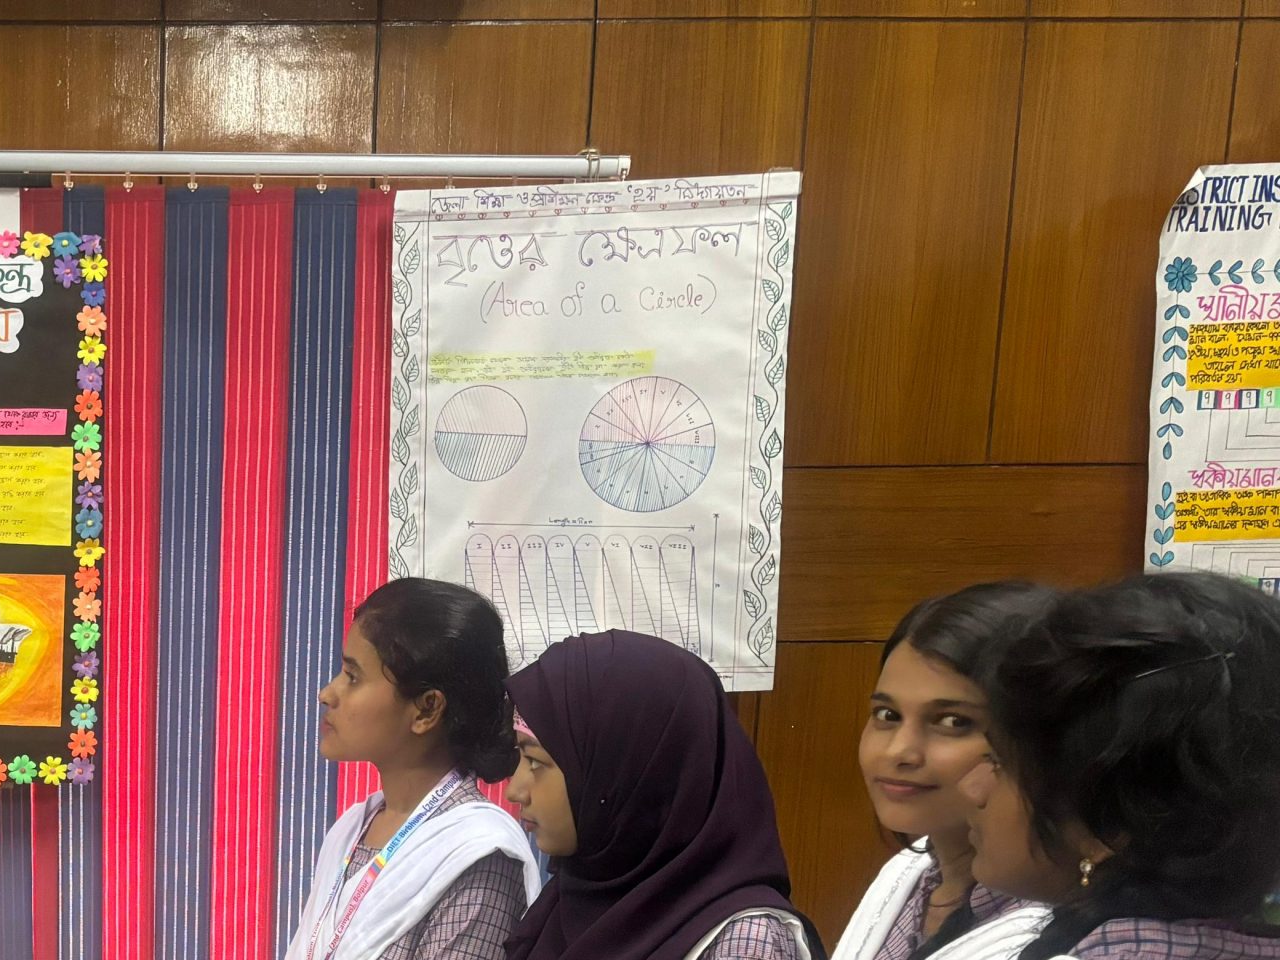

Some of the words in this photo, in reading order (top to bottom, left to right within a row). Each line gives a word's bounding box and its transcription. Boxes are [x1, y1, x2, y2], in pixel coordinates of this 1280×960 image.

[1167, 204, 1272, 232] TRAINING
[561, 281, 585, 318] of
[602, 293, 621, 314] a
